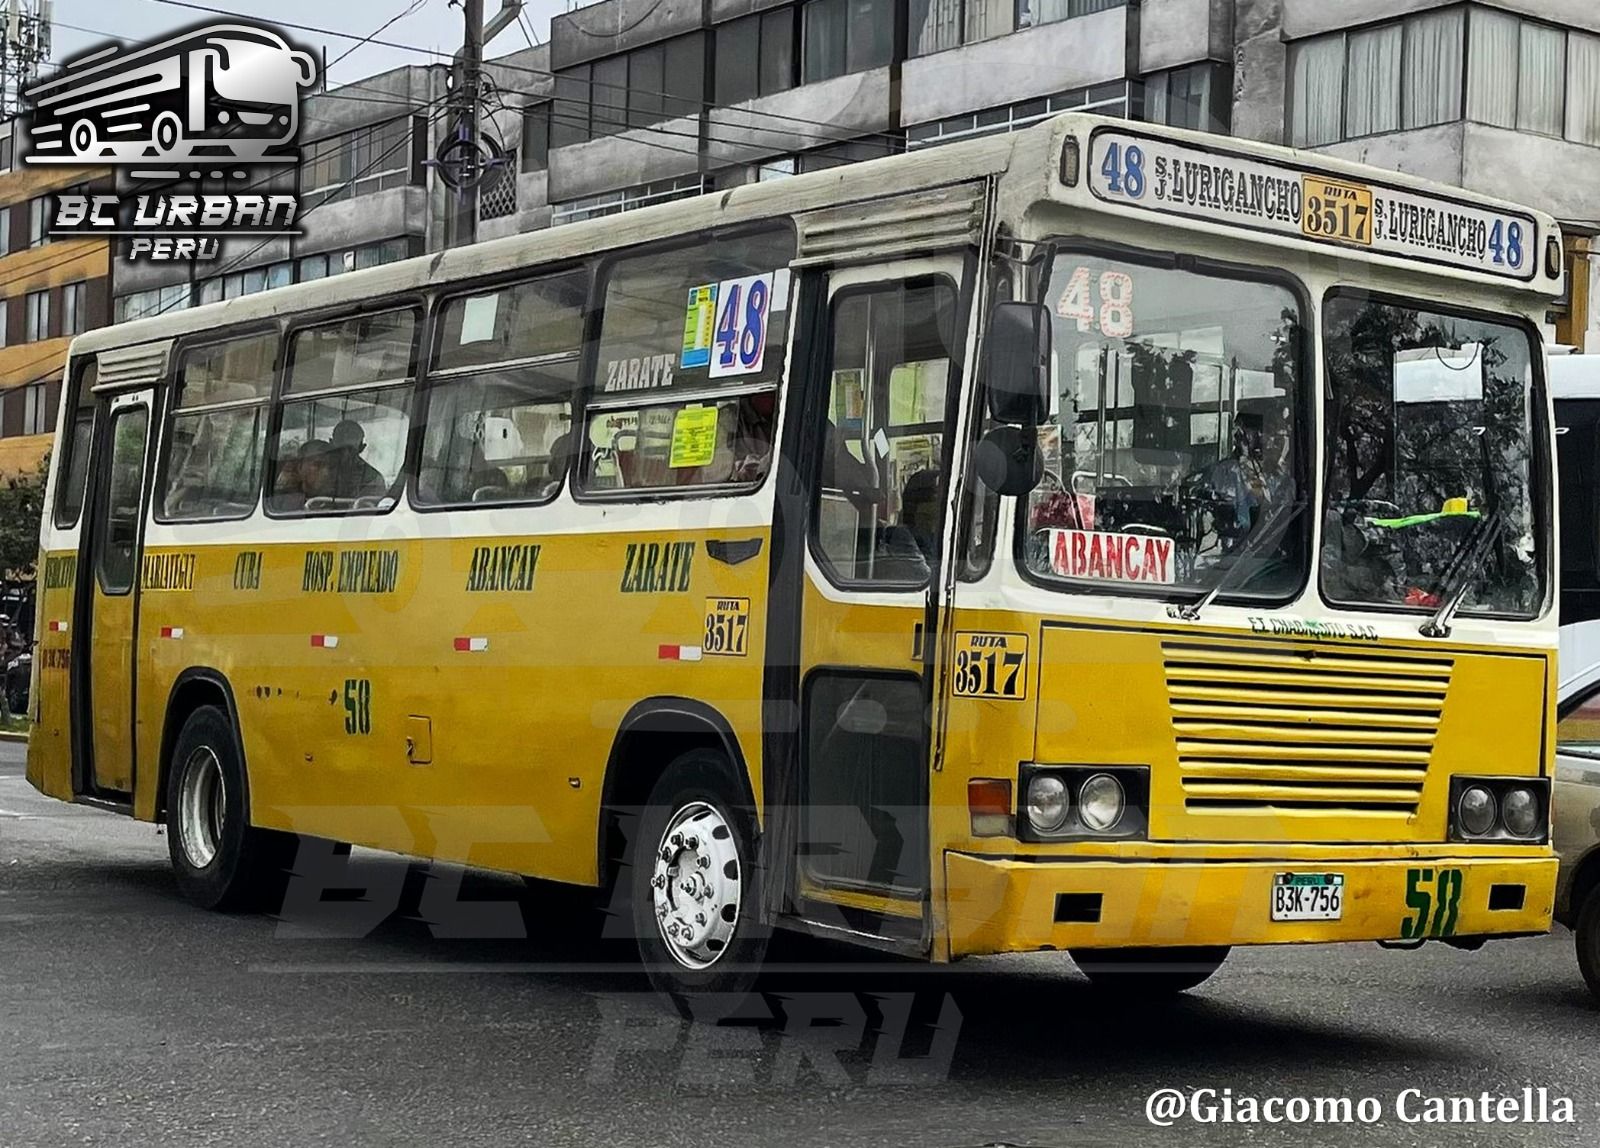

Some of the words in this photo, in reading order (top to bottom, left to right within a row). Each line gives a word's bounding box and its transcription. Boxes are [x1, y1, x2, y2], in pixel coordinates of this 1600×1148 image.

[1101, 142, 1147, 199] 48
[1324, 186, 1358, 200] RUTA
[1307, 196, 1369, 240] 3517
[1488, 219, 1524, 269] 48
[715, 279, 769, 369] 48
[1055, 266, 1134, 338] 48
[605, 354, 676, 392] ZARATE
[233, 551, 263, 590] CUBA
[302, 551, 334, 592] HOSP.
[337, 550, 399, 593] EMPLEADO
[465, 545, 541, 591] ABANCAY
[620, 542, 695, 592] ZARATE
[1053, 531, 1171, 582] ABANCAY
[717, 601, 740, 611] RUTA
[705, 613, 747, 652] 3517
[971, 635, 1007, 648] RUTA
[956, 650, 1024, 695] 3517
[345, 679, 371, 735] 58
[1276, 886, 1340, 912] B3K-756
[1401, 868, 1463, 939] 58
